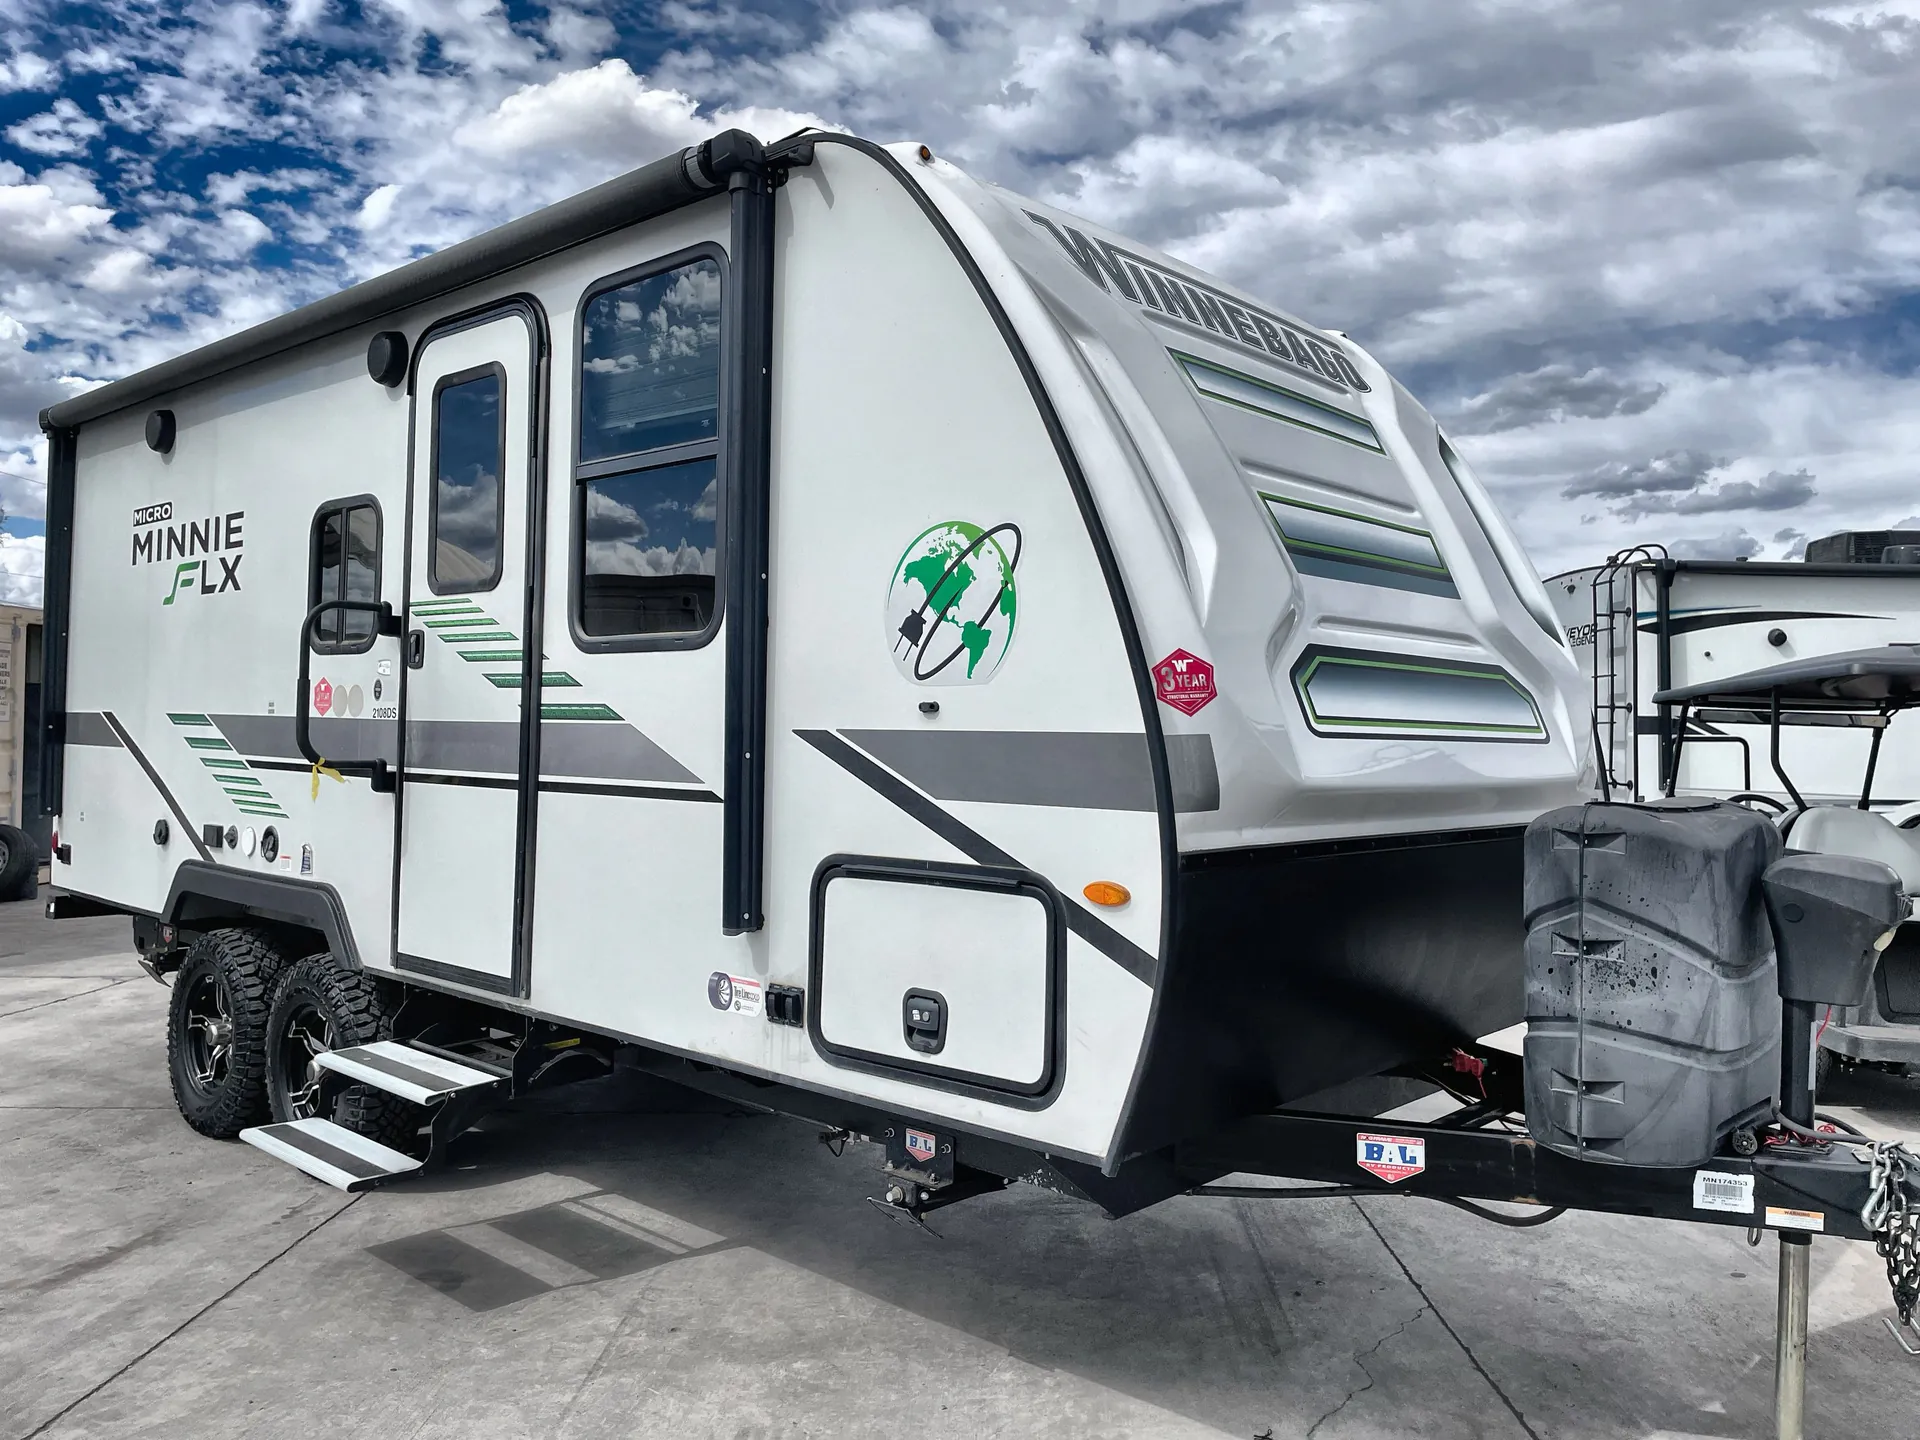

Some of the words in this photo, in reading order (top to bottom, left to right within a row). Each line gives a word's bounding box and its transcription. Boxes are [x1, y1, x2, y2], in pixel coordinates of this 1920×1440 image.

[1021, 208, 1372, 394] WINNEBAGO
[134, 503, 172, 526] MICRO
[132, 511, 244, 566] MINNIE
[163, 554, 243, 605] FLX
[1161, 666, 1175, 691] 3
[1176, 673, 1207, 688] YEAR
[372, 707, 397, 719] 2108DS
[1702, 1176, 1748, 1187] MN174353
[1783, 1210, 1811, 1218] WARNING
